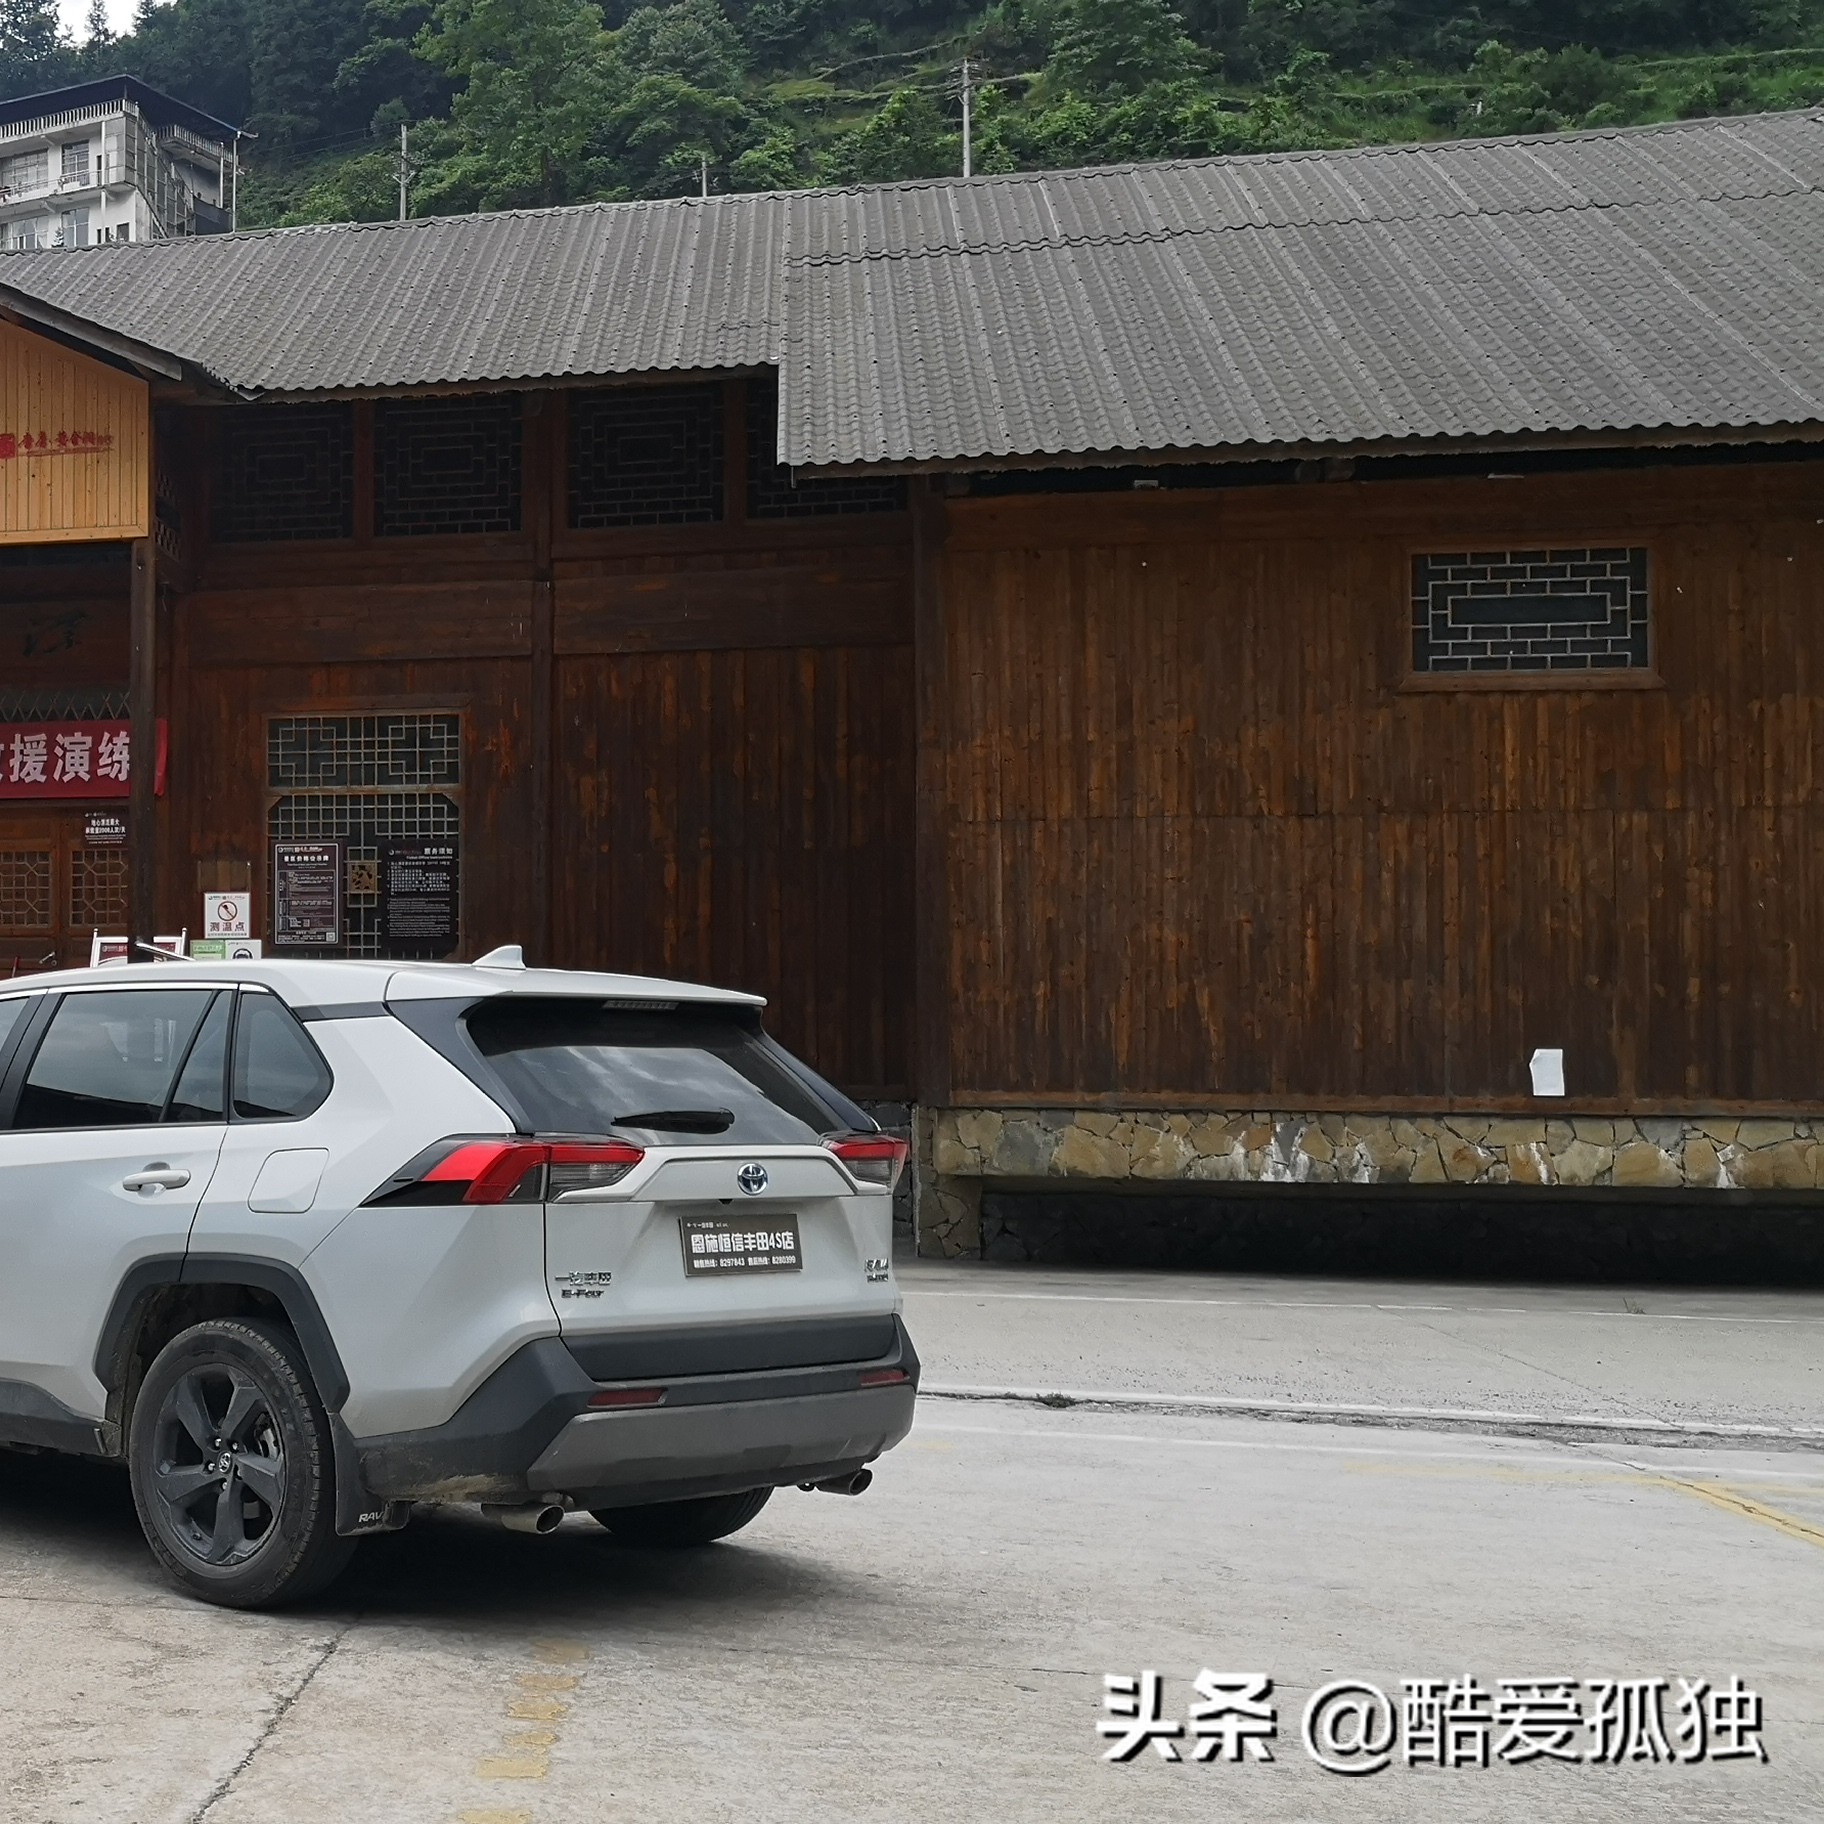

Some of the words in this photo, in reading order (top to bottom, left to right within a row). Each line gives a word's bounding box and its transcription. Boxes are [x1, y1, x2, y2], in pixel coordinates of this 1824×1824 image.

[209, 921, 245, 932] 测温点
[690, 1230, 795, 1254] 恩施恒信丰田4S店
